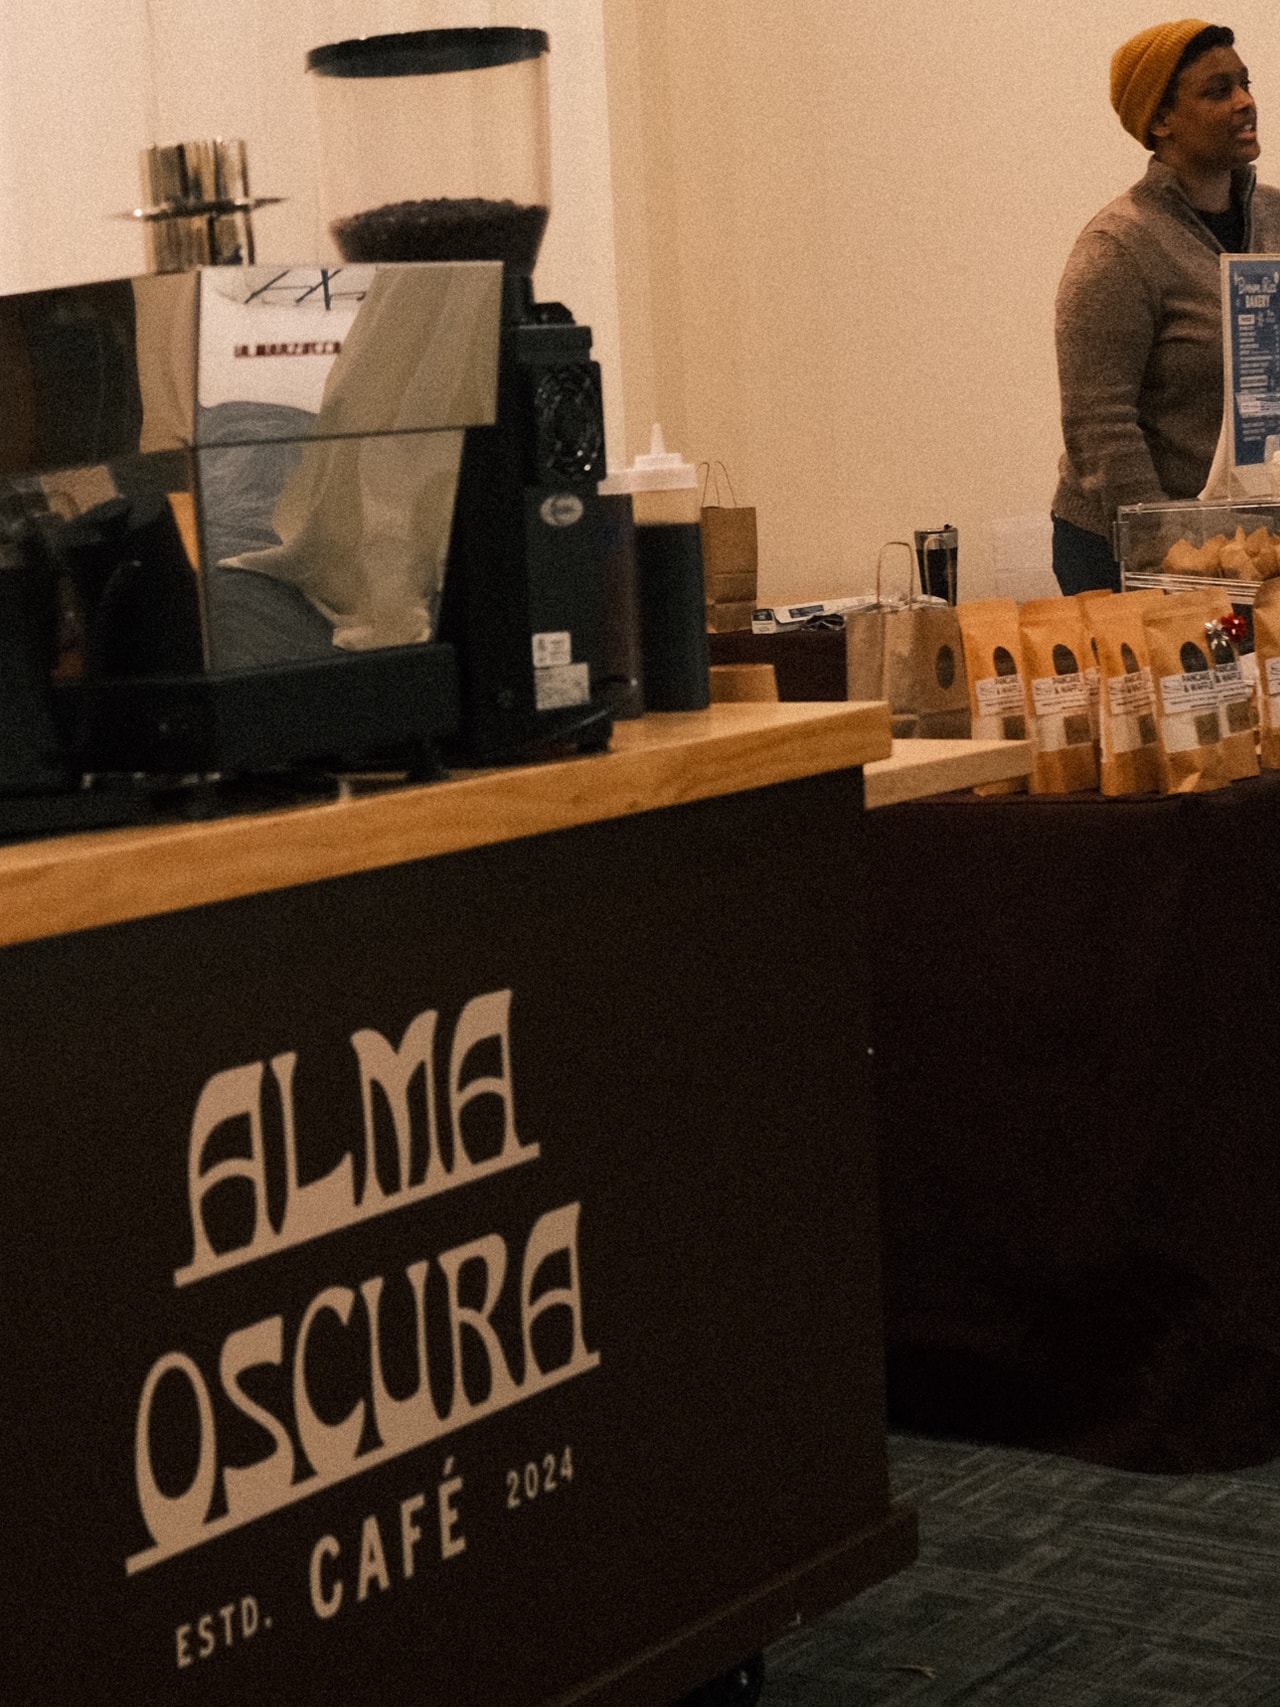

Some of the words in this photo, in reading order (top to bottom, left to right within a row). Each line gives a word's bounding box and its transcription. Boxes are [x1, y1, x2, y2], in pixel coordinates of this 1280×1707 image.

[175, 988, 540, 1287] ALMA
[126, 1202, 600, 1575] OSCURA
[176, 1597, 273, 1667] ESTD.
[310, 1457, 465, 1618] CAFÉ
[506, 1447, 574, 1508] 2024
